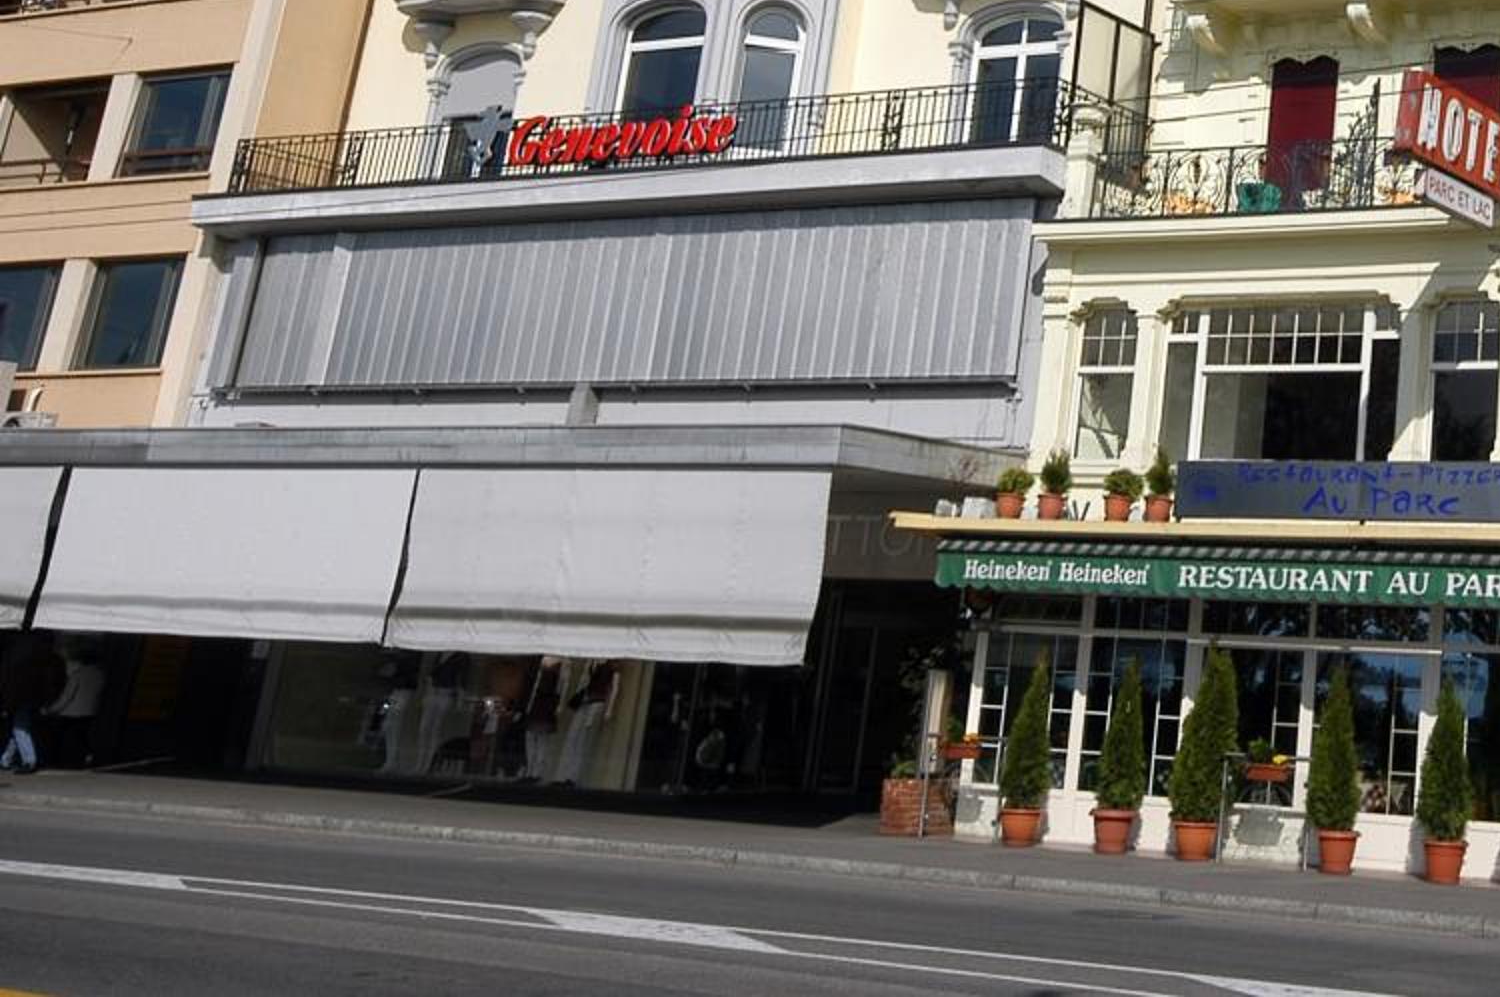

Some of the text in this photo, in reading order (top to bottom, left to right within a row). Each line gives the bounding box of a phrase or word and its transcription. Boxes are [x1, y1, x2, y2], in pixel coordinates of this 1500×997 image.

[509, 105, 737, 166] Genevoise
[1429, 176, 1454, 203] PARC
[1457, 191, 1469, 213] ET
[964, 559, 1052, 582] Heineken
[1058, 562, 1150, 585] Heineken
[1177, 565, 1373, 593] RESTAURANT
[1387, 572, 1429, 595] AU
